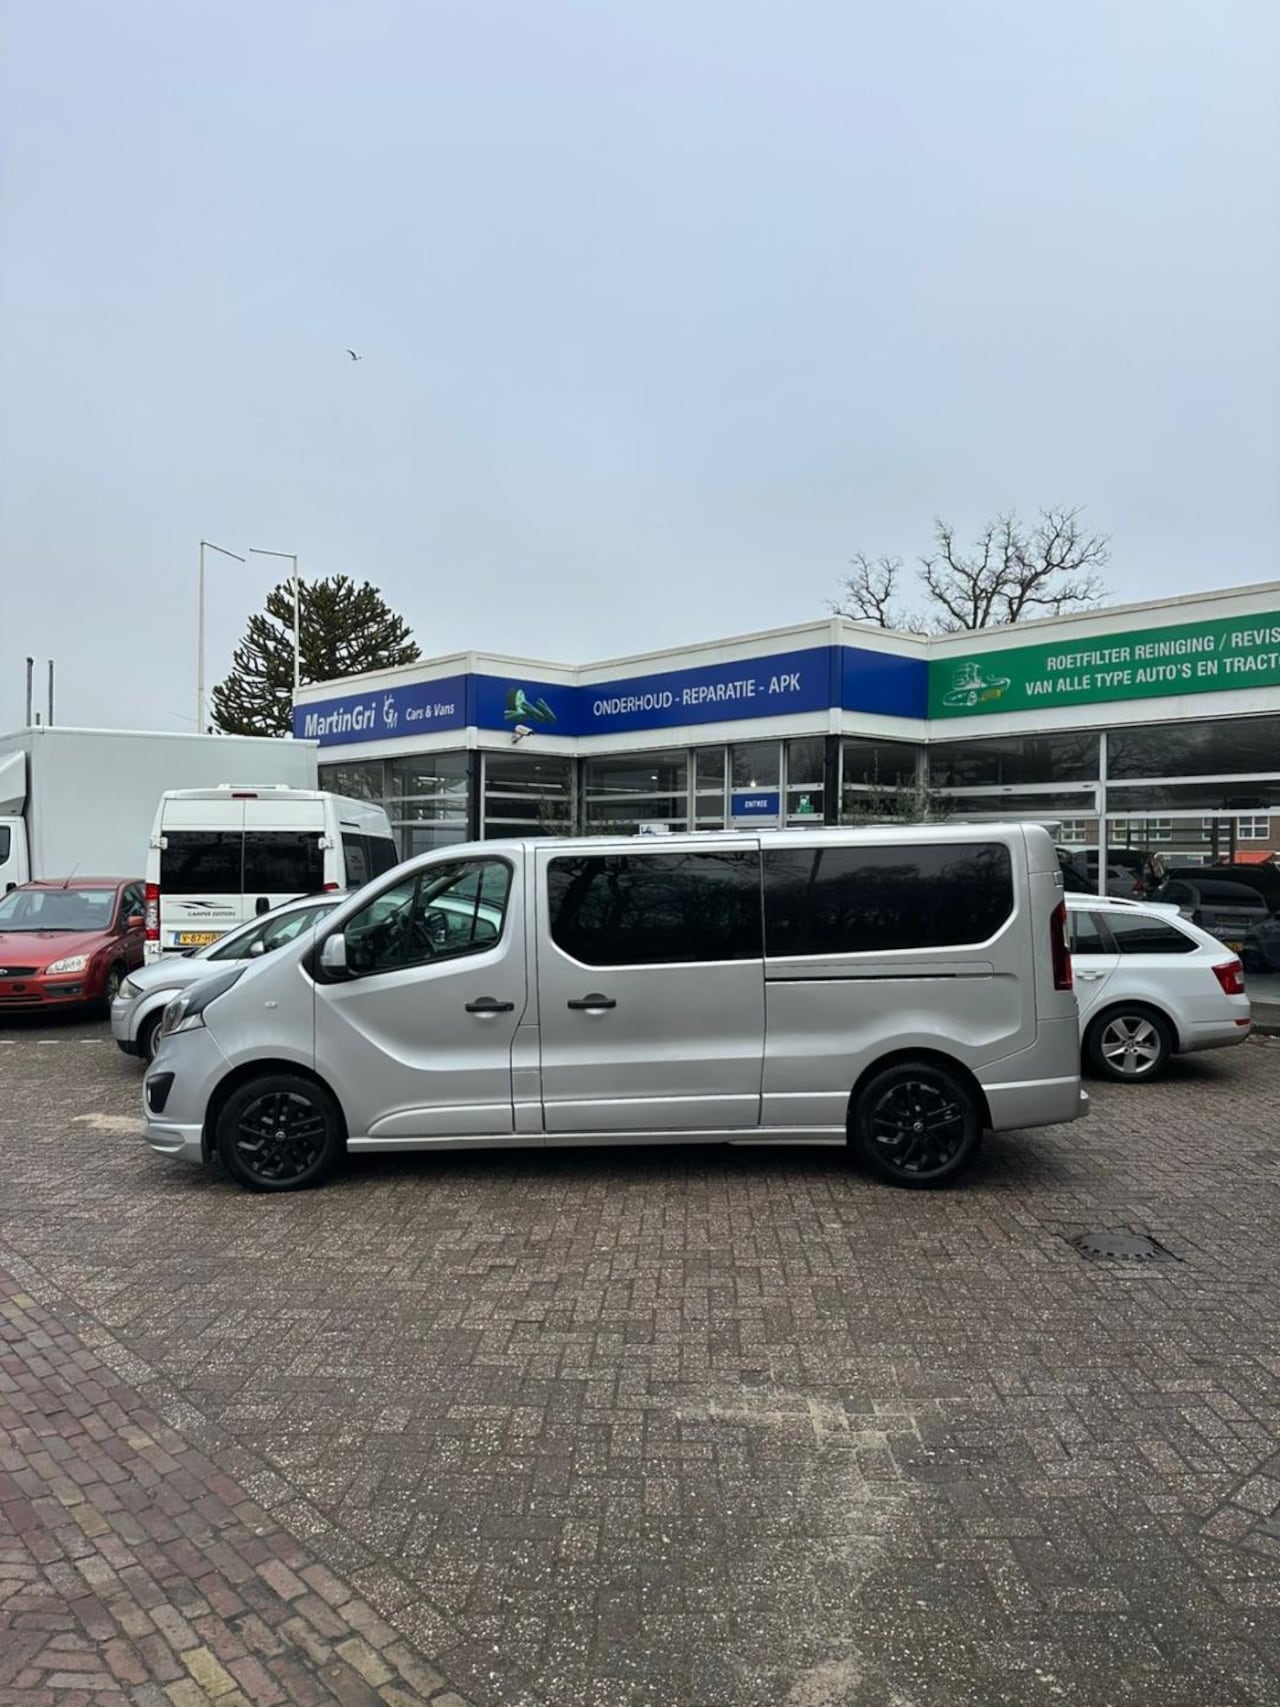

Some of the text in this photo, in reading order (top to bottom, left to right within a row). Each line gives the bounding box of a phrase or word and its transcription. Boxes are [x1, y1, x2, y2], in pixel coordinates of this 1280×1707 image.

[1046, 647, 1131, 671] ROETFILTER
[1134, 635, 1215, 660] REINIGING
[1219, 633, 1227, 651] /
[1025, 653, 1280, 696] VAN ALLE TYPE AUTO'S EN TRACT
[405, 703, 455, 721] Cars & Vans
[593, 691, 672, 716] ONDERHOUD
[683, 679, 756, 706] REPARATIE
[769, 673, 801, 693] APK
[304, 702, 376, 737] MartinGri
